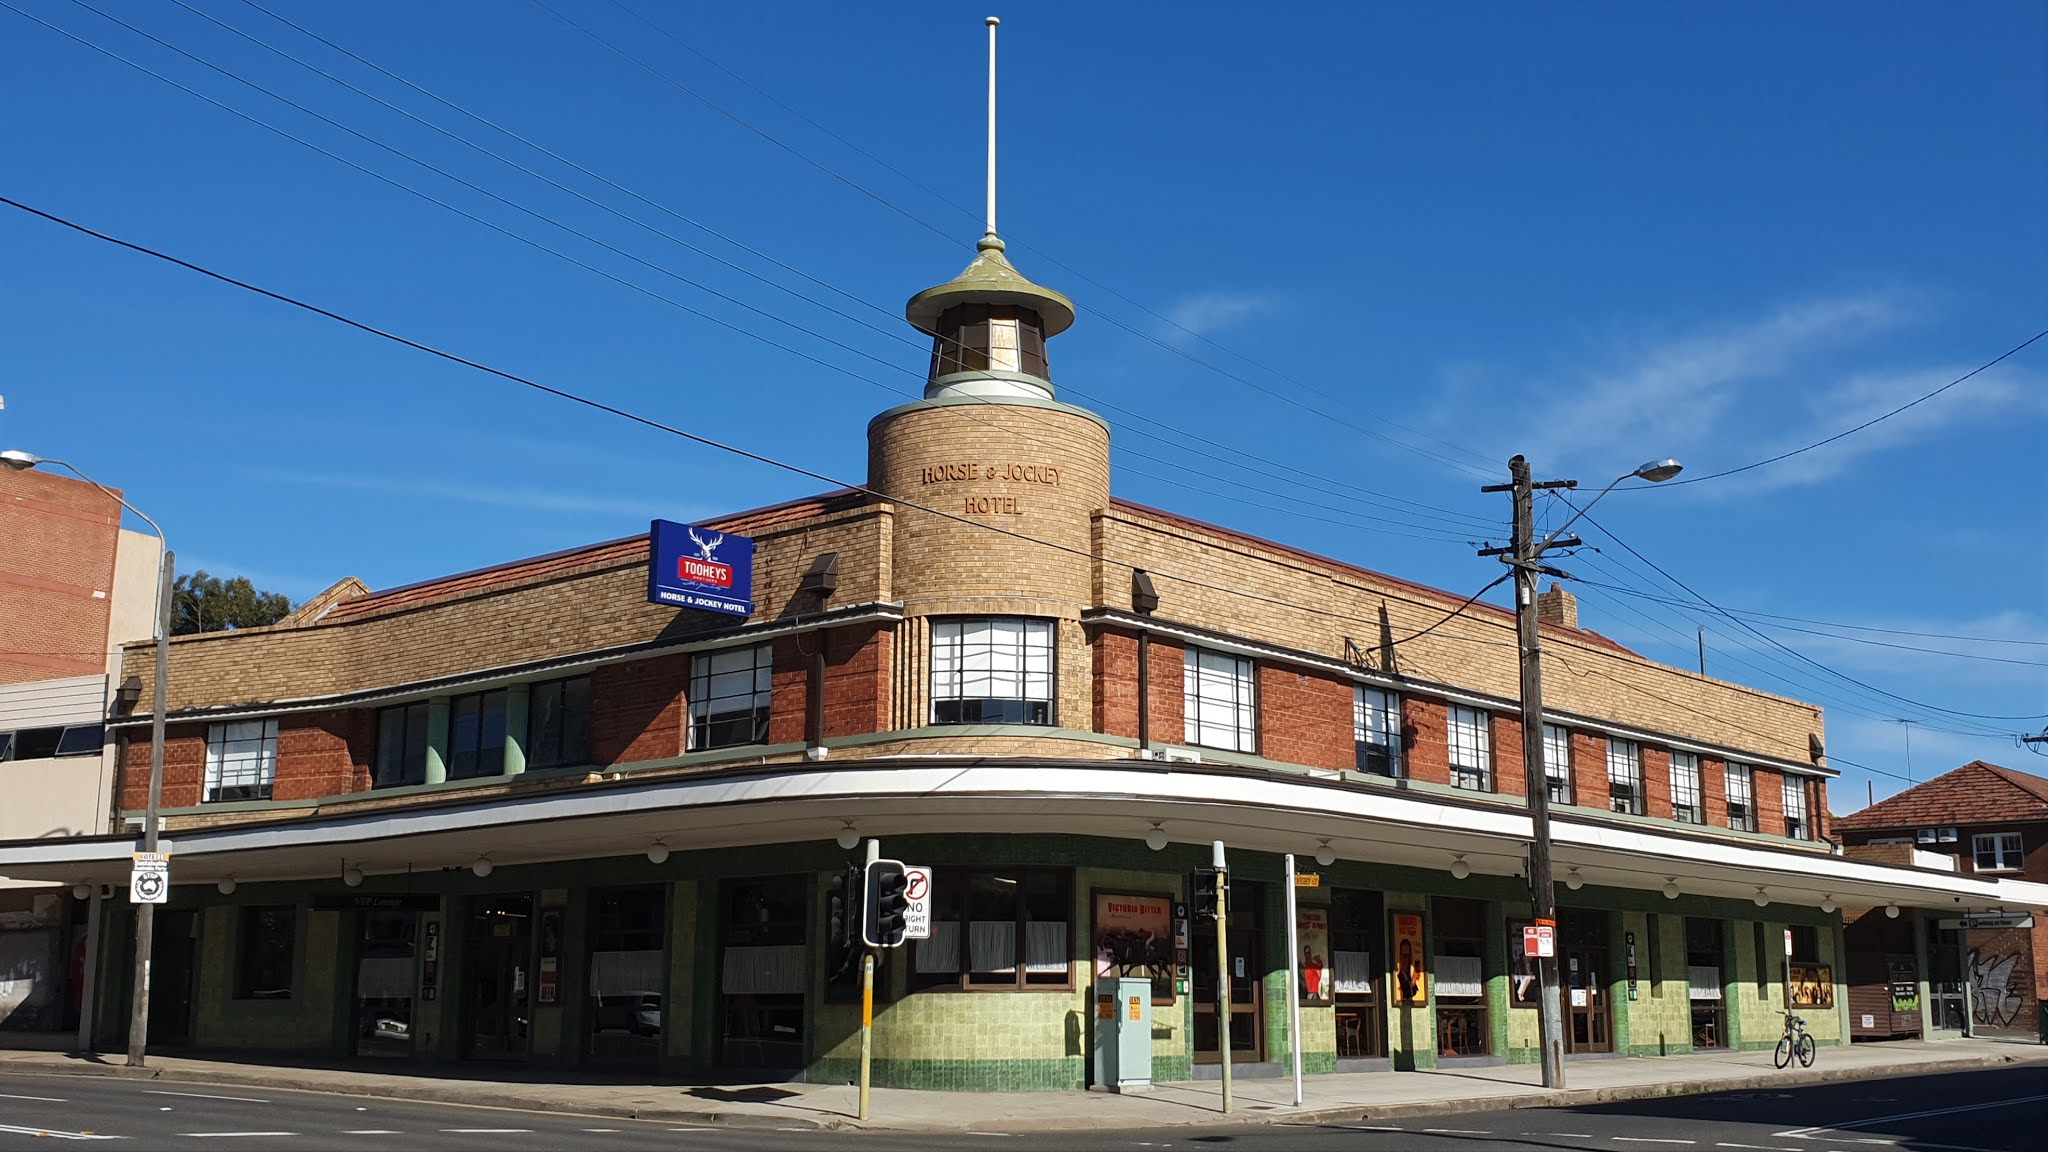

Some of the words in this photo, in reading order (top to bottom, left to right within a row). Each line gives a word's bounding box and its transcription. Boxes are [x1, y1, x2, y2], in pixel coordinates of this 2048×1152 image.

[922, 463, 979, 485] HORSE
[986, 467, 996, 480] &
[1002, 463, 1061, 486] JOCKEY
[965, 497, 1023, 515] HOTEL
[684, 561, 727, 581] TOOHEYS
[660, 591, 686, 602] HORSE
[687, 596, 693, 604] &
[694, 598, 722, 608] JOCKEY
[723, 602, 746, 613] HOTEL
[142, 872, 158, 880] STOP
[907, 902, 923, 912] NO
[1108, 902, 1138, 913] VICTORIA
[1140, 904, 1162, 915] BITTER
